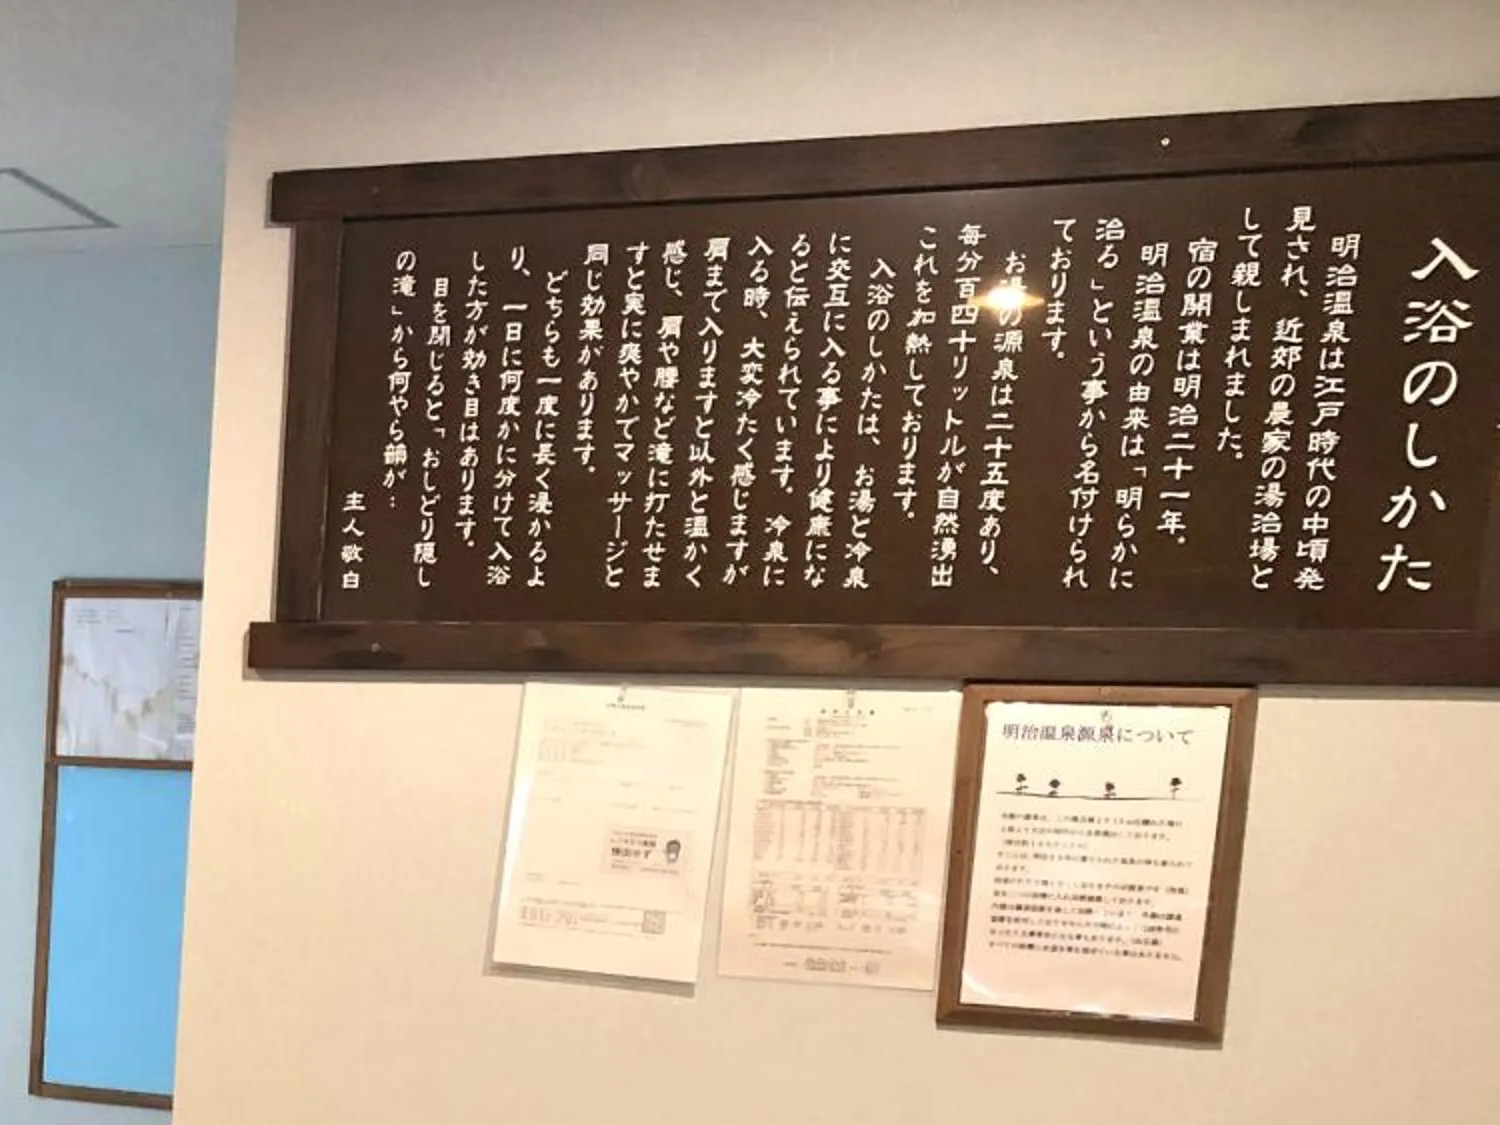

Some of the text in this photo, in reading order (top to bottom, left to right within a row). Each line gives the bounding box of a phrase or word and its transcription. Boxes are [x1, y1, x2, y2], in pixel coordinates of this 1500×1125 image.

[413, 277, 451, 587] 目を閉じると「おしどり隠し
[455, 251, 489, 547] した方が効き目はあります。
[487, 246, 531, 585] り、一日に何度かに分けて入浴
[573, 243, 609, 473] 同じ効果があります。
[642, 239, 688, 588] 感じ、肩や腰など滝に打たせま
[722, 235, 774, 585] 入る時、大変冷たく感じますが
[762, 233, 811, 587] ると伝えられています。冷泉に
[803, 232, 852, 588] に交互に入る事により健康にな
[842, 257, 897, 589] 入浴のしかたは、お湯と冷泉
[892, 226, 939, 519] これを加熱しております。
[931, 223, 987, 587] 毎分百四十リットルが自然湧出
[1039, 218, 1077, 359] ております。
[1062, 217, 1125, 589] 治る」という事から名付けられ
[1109, 242, 1169, 590] 明治温泉の由来は「明らかに
[1158, 237, 1218, 544] 宿の開業は明治二十一年。
[1217, 207, 1263, 459] して親しまれました。
[1249, 205, 1316, 589] 見され、近郊の農家の湯治場と
[1293, 233, 1361, 591] 明治温泉は江戸時代の中頃発
[1377, 239, 1480, 592] 入浴のしかた
[341, 491, 366, 589] 主人敬白
